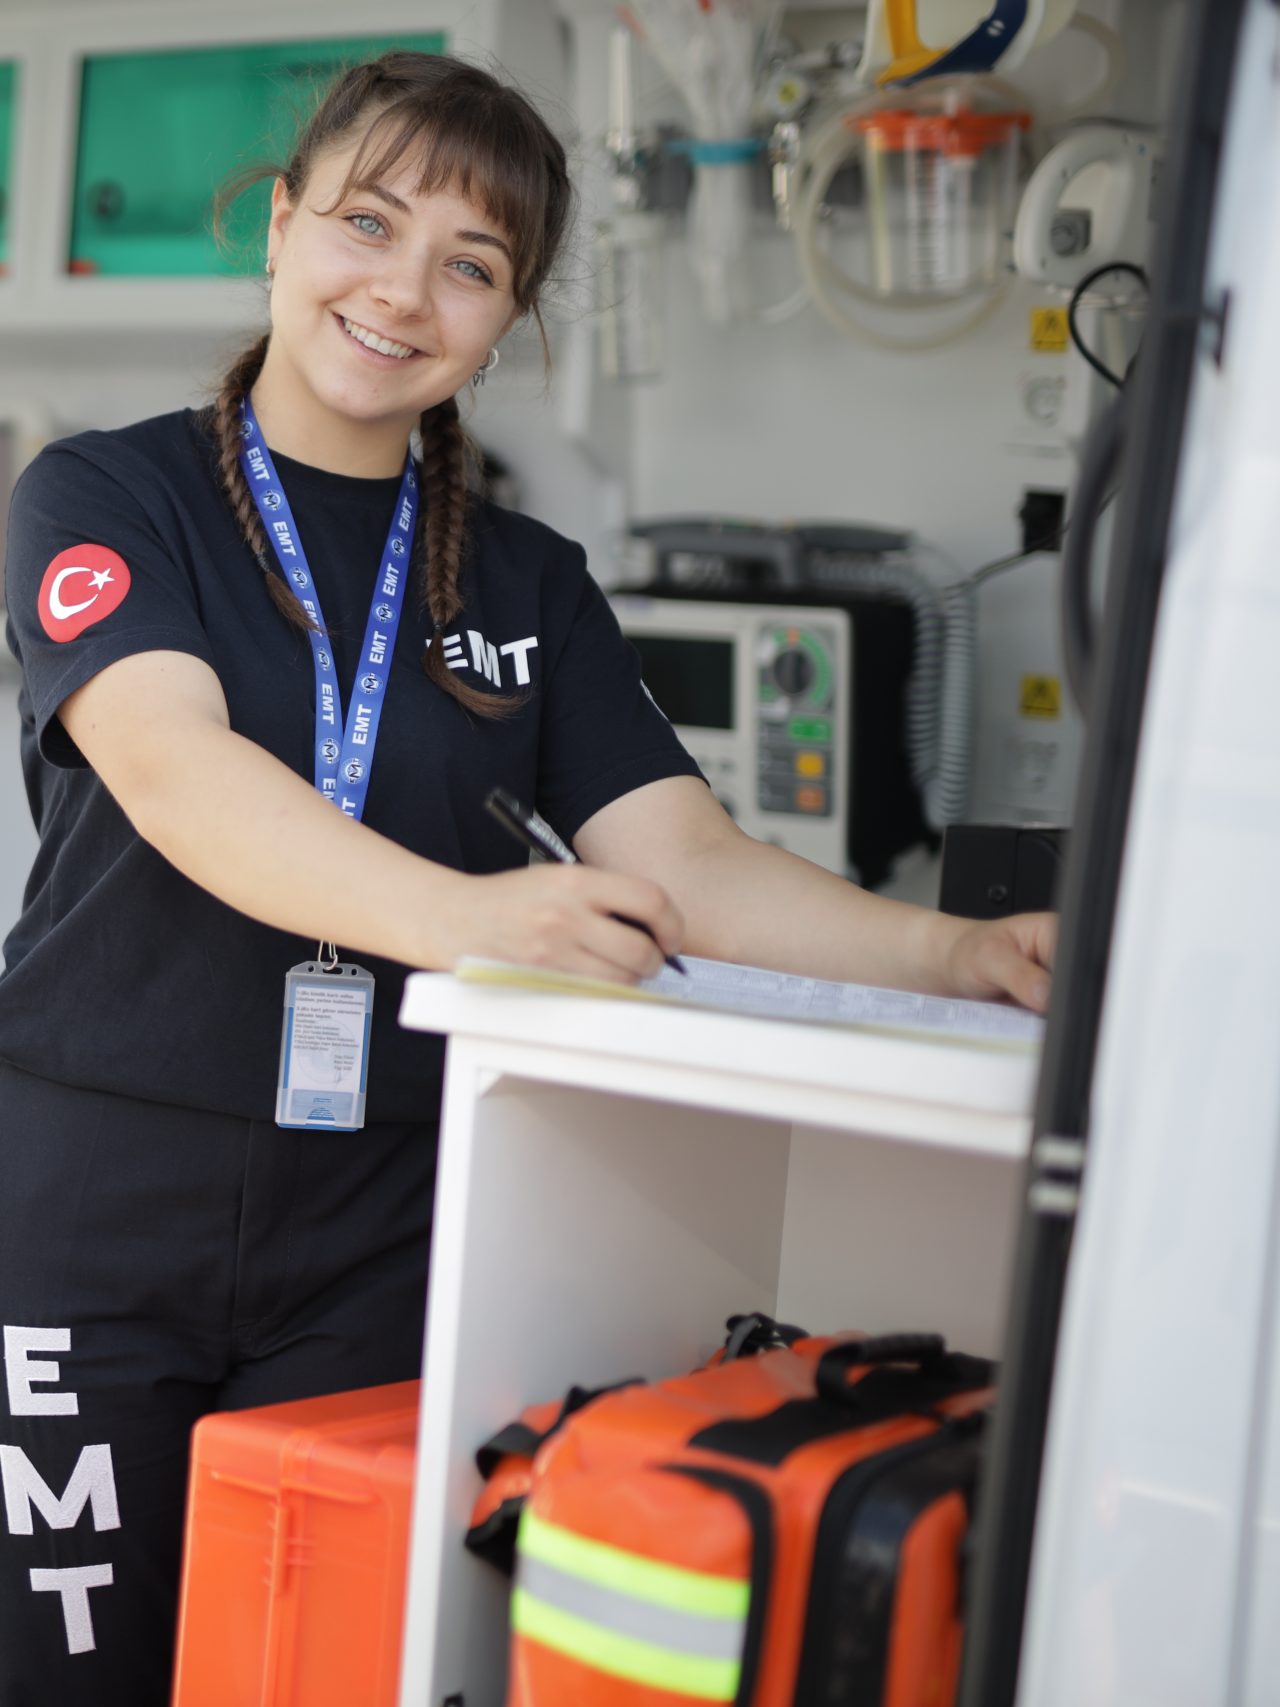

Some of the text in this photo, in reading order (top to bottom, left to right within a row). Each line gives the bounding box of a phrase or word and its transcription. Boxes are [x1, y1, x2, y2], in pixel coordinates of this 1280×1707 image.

[247, 446, 271, 480] EMT
[399, 496, 413, 532] EMT
[272, 520, 296, 557] EMT
[382, 562, 400, 597] EMT
[369, 630, 388, 665] EMT
[425, 629, 539, 688] EMT
[321, 682, 335, 726] EMT
[352, 703, 373, 746] EMT
